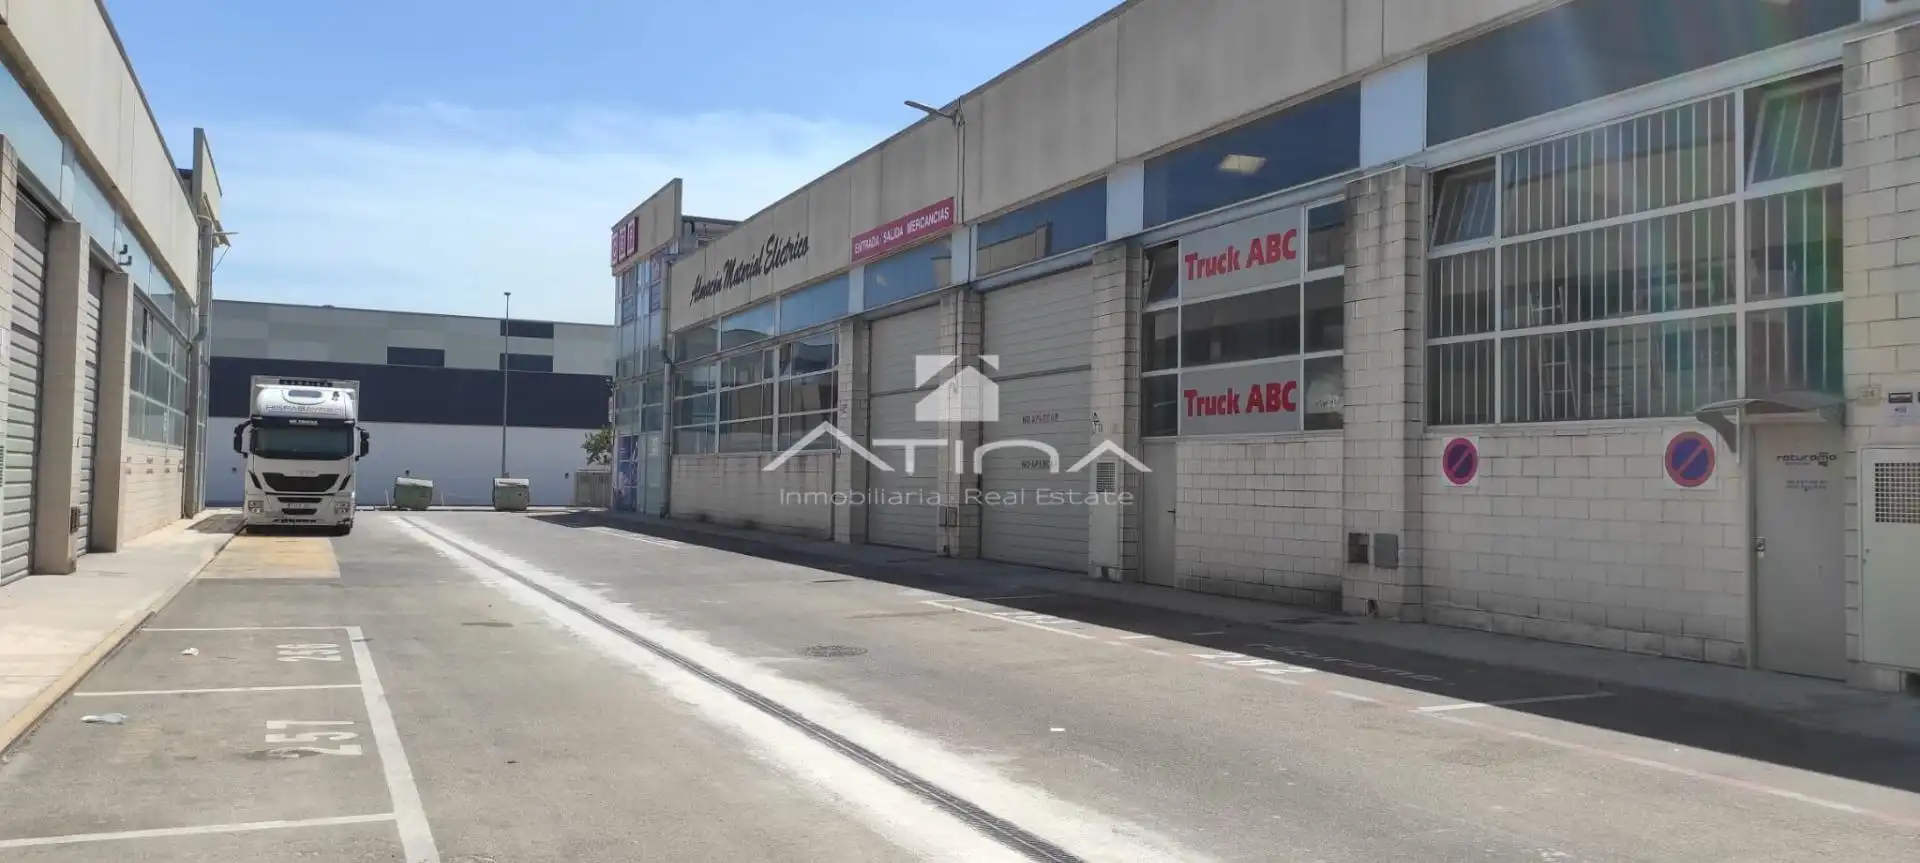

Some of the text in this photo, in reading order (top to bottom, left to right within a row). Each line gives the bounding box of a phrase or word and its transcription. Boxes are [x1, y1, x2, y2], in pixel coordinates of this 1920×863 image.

[854, 235, 880, 254] ENTRADA
[882, 223, 904, 244] SALIDA
[1184, 228, 1298, 281] Truck ABC
[1183, 380, 1298, 417] Truck ABC
[265, 719, 362, 760] 257
